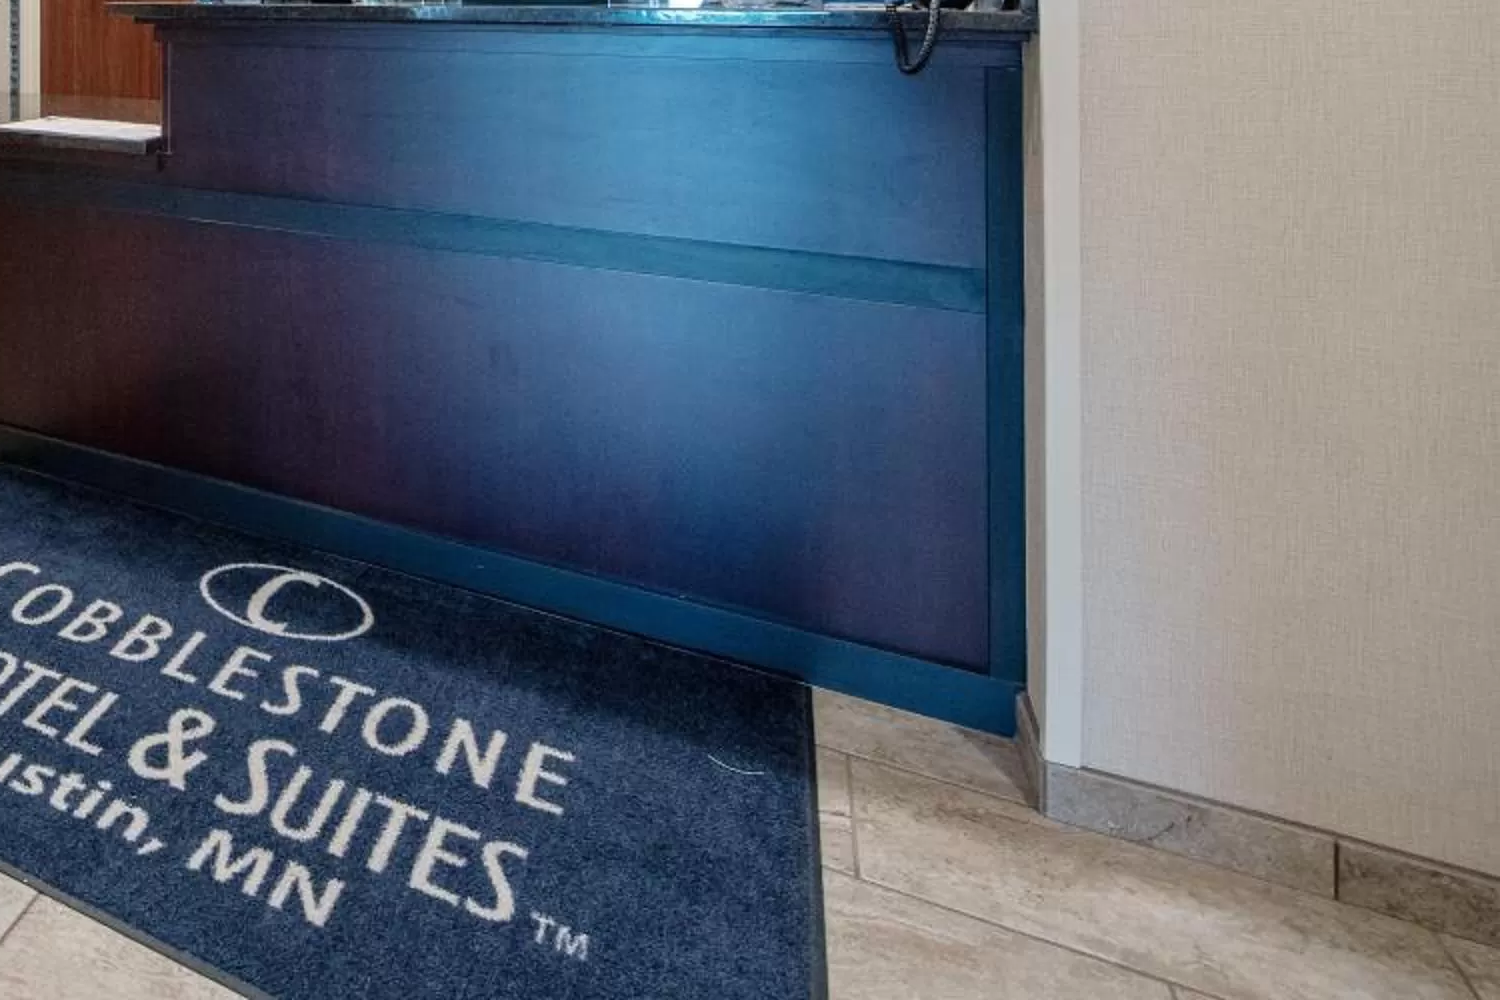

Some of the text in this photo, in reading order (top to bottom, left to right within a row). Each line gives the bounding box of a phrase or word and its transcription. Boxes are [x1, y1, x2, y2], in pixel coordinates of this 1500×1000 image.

[127, 707, 218, 792] &
[214, 738, 529, 922] SUITES
[185, 828, 347, 929] MN
